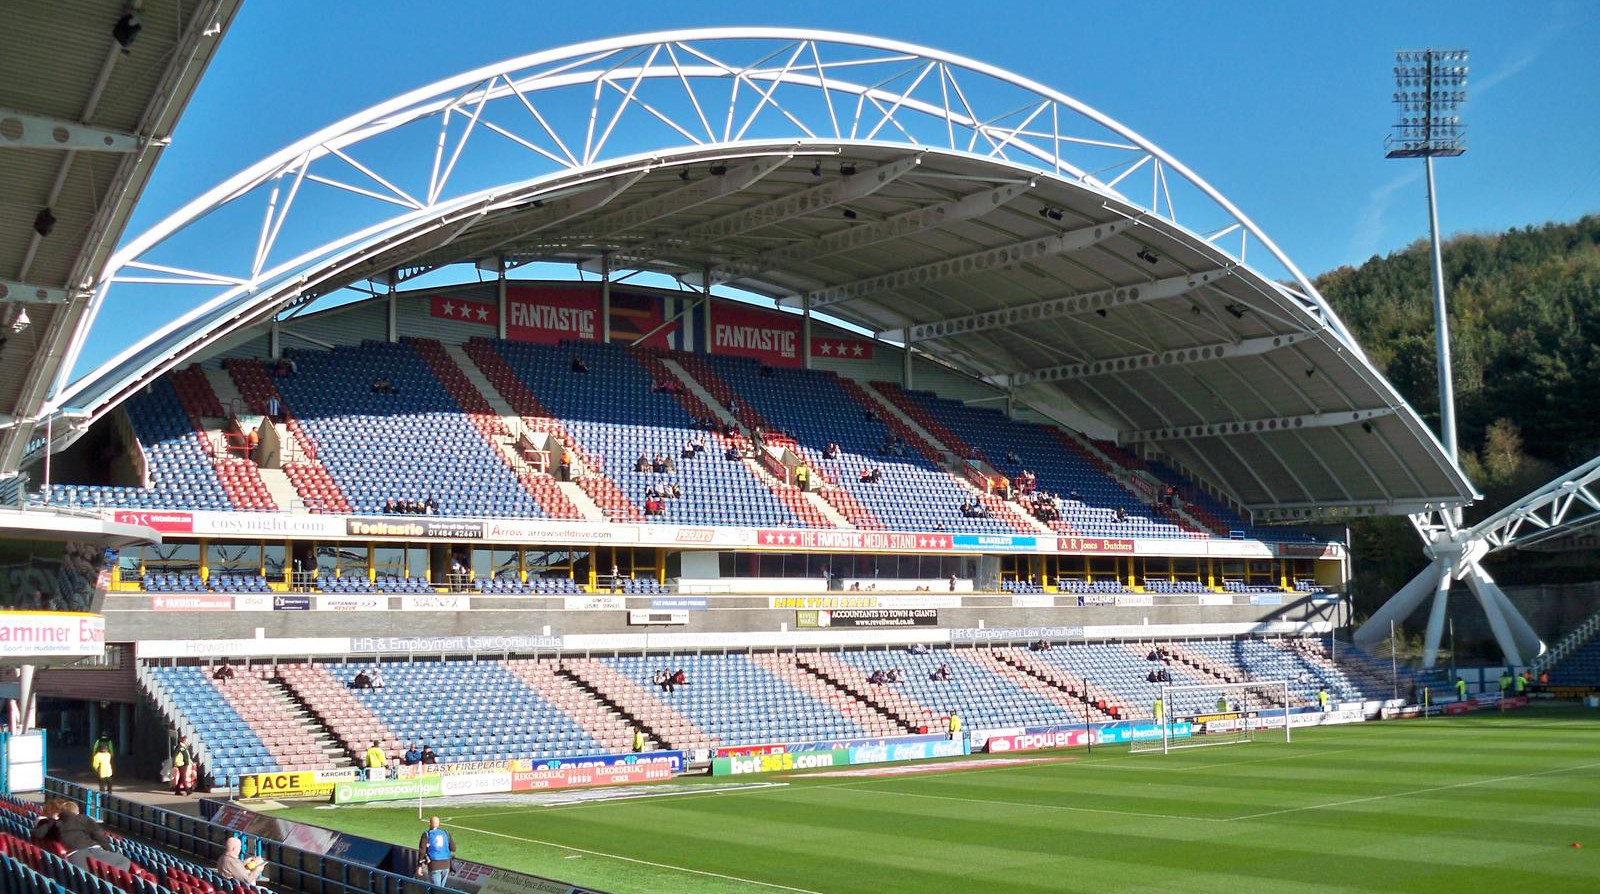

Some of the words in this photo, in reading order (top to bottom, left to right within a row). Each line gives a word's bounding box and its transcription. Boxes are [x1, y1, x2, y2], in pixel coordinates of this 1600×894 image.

[511, 301, 594, 333] FANTASTIC
[715, 324, 796, 352] FANTASTIC
[211, 515, 324, 532] cosynight.com
[455, 530, 482, 538] 426611
[491, 524, 523, 536] Arrow
[528, 528, 612, 539] arrowselfdrive.com
[680, 529, 714, 541] PERRYS
[800, 531, 815, 546] THE
[817, 532, 863, 547] FANTASTIC
[864, 533, 888, 548] MEDIA
[891, 534, 917, 549] STAND
[1061, 538, 1068, 549] A
[1071, 538, 1078, 549] R
[1080, 539, 1098, 551] Jones
[1104, 540, 1132, 551] Butchers
[774, 597, 806, 608] LINK
[807, 597, 838, 608] TYRE
[840, 598, 878, 608] SALES
[832, 610, 879, 618] ACCOUNTANTS
[950, 630, 964, 640] HR
[974, 629, 1021, 641] Employment
[1023, 628, 1039, 639] Law
[1041, 627, 1083, 638] Consultants
[185, 639, 243, 654] Howarth
[354, 638, 373, 650] HR
[377, 638, 386, 650] &
[390, 637, 464, 652] Employment
[467, 636, 491, 648] Law
[495, 635, 562, 648] Consultants
[1014, 731, 1073, 749] npower
[427, 763, 453, 773] EASY
[456, 760, 509, 771] FIREPLACE
[595, 764, 644, 776] REKORDERLIG
[730, 753, 833, 775] bet365.com
[514, 769, 565, 781] REKORDERLIG
[611, 774, 629, 782] CIDER
[262, 775, 300, 790] ACE
[530, 780, 550, 788] CIDER
